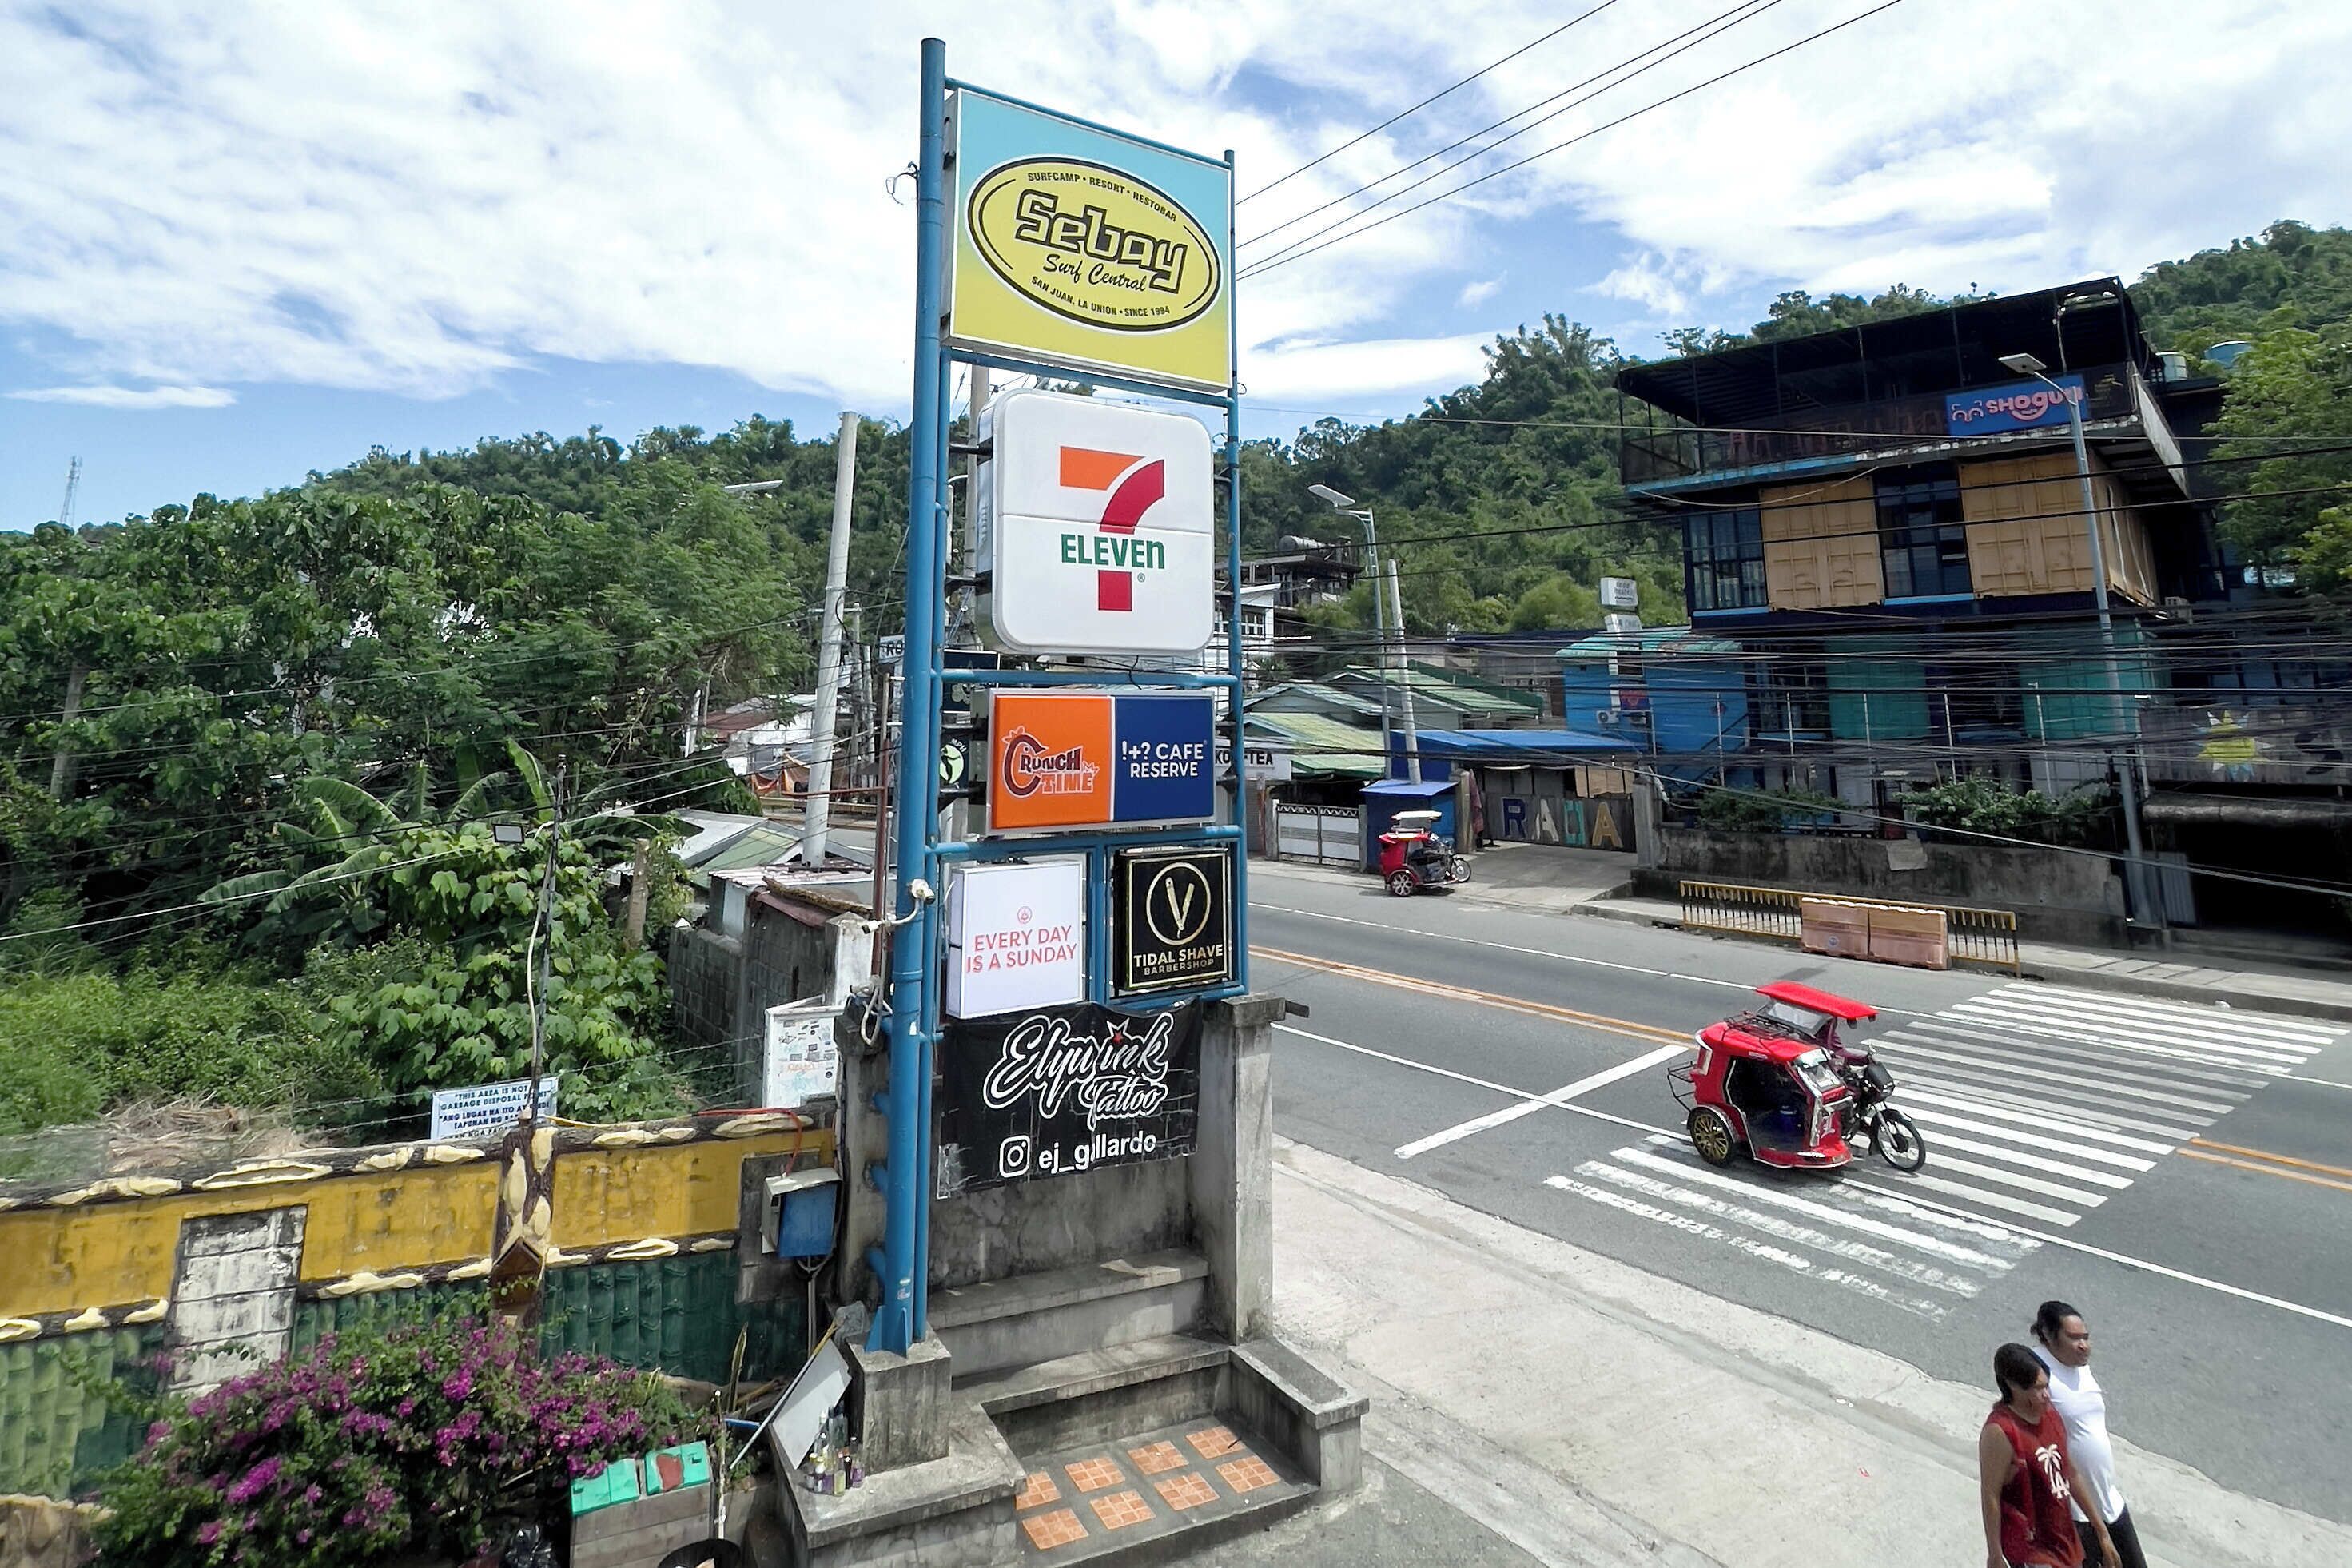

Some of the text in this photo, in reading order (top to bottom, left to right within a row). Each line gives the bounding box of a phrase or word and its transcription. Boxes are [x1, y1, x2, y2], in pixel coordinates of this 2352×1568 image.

[1028, 171, 1178, 223] SURFCAMP RESORT RESTOBAR
[1015, 189, 1188, 294] Sebay
[1042, 253, 1147, 293] Surf Central
[1031, 275, 1171, 317] SAN JUAN, LA UNION SINCE 1994
[1059, 445, 1165, 612] 7
[1156, 742, 1204, 761] CAFE
[1041, 772, 1093, 794] TIME
[1130, 762, 1198, 778] RESERVE
[974, 925, 1072, 952] EVERY DAY
[966, 943, 1077, 973] IS A SUNDAY
[1133, 944, 1224, 968] TIDAL SHAVE
[1144, 958, 1214, 976] BARBERSHOP
[440, 1100, 480, 1111] GARBAGE
[483, 1095, 522, 1106] DISPOSAL
[1082, 1073, 1164, 1125] Tattoo
